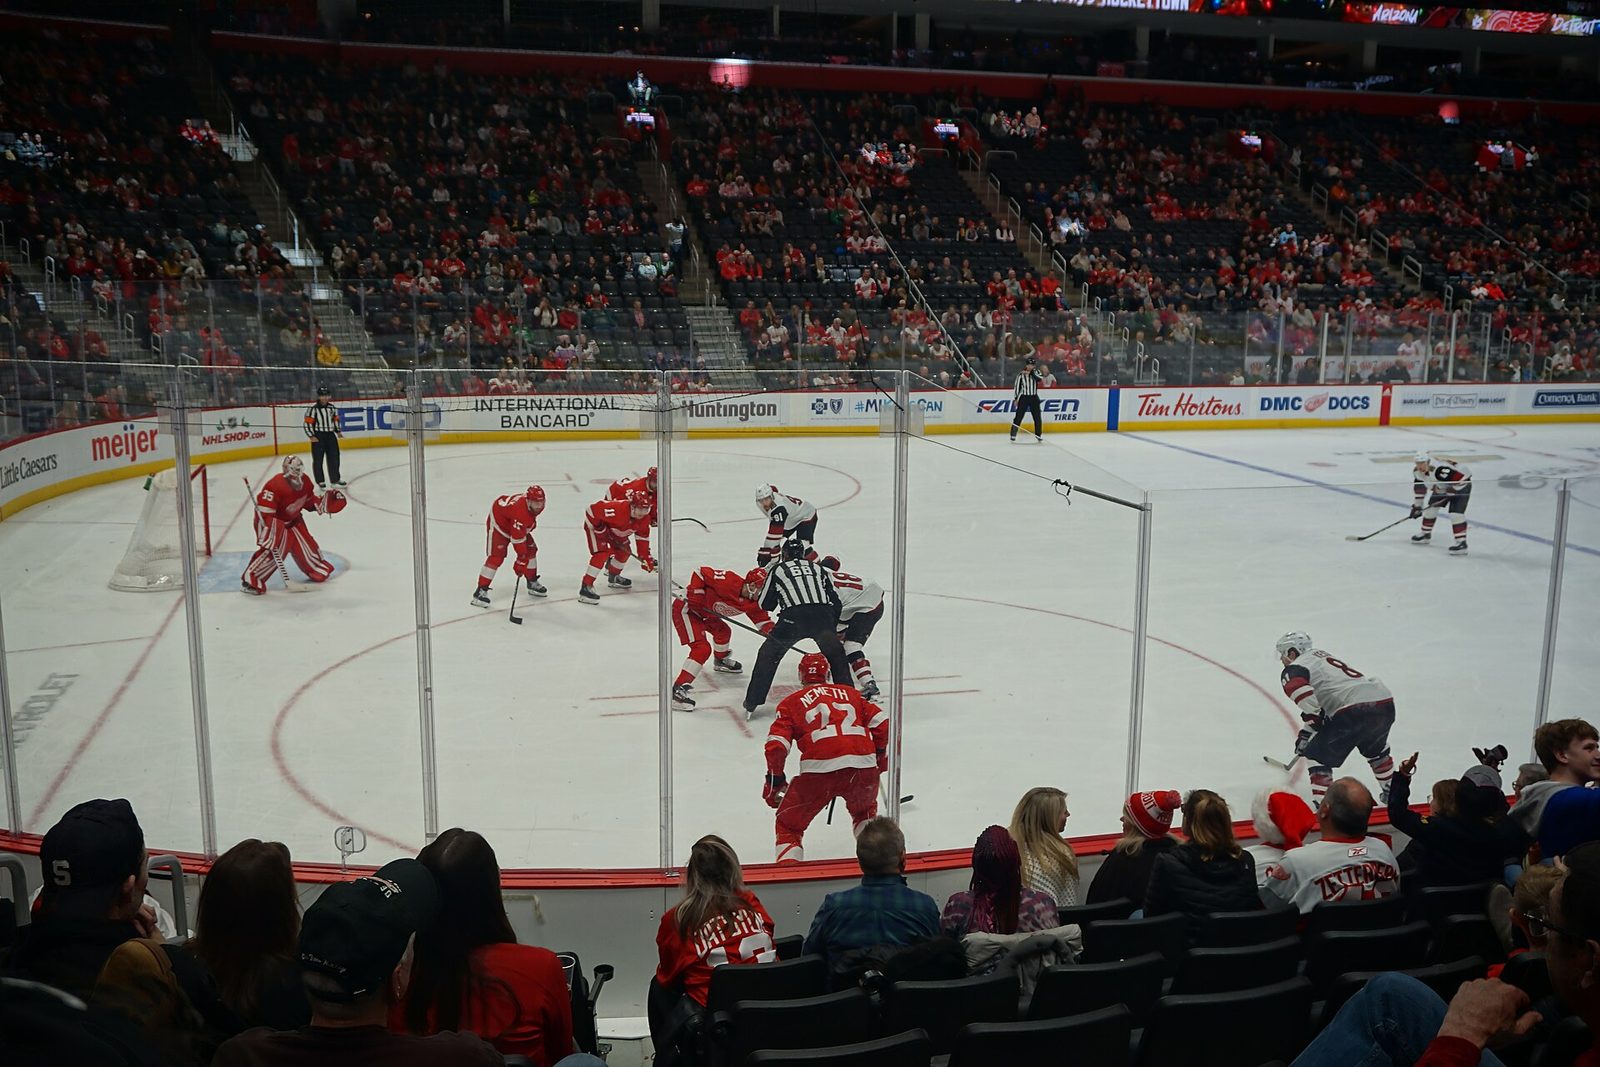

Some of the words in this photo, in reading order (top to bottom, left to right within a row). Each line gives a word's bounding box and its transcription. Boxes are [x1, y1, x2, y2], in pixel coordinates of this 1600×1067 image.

[1372, 5, 1418, 23] ARIZONA
[475, 397, 619, 413] INTERNATIONAL
[977, 399, 1079, 413] FAEN
[1138, 394, 1170, 416] Tim
[1173, 392, 1241, 416] Hortons
[1260, 397, 1302, 411] DMC
[1328, 396, 1370, 410] DOCS
[1577, 392, 1598, 403] Bank
[337, 403, 442, 432] EICO
[682, 400, 777, 422] Huntington
[1054, 413, 1077, 421] TIRES
[92, 424, 158, 462] meijer
[0, 462, 19, 489] Little
[20, 454, 57, 479] Caesars
[262, 490, 274, 501] 35
[800, 687, 849, 708] NEMETH
[805, 702, 866, 743] 22
[52, 860, 71, 886] S
[1313, 861, 1398, 900] ZETTERER
